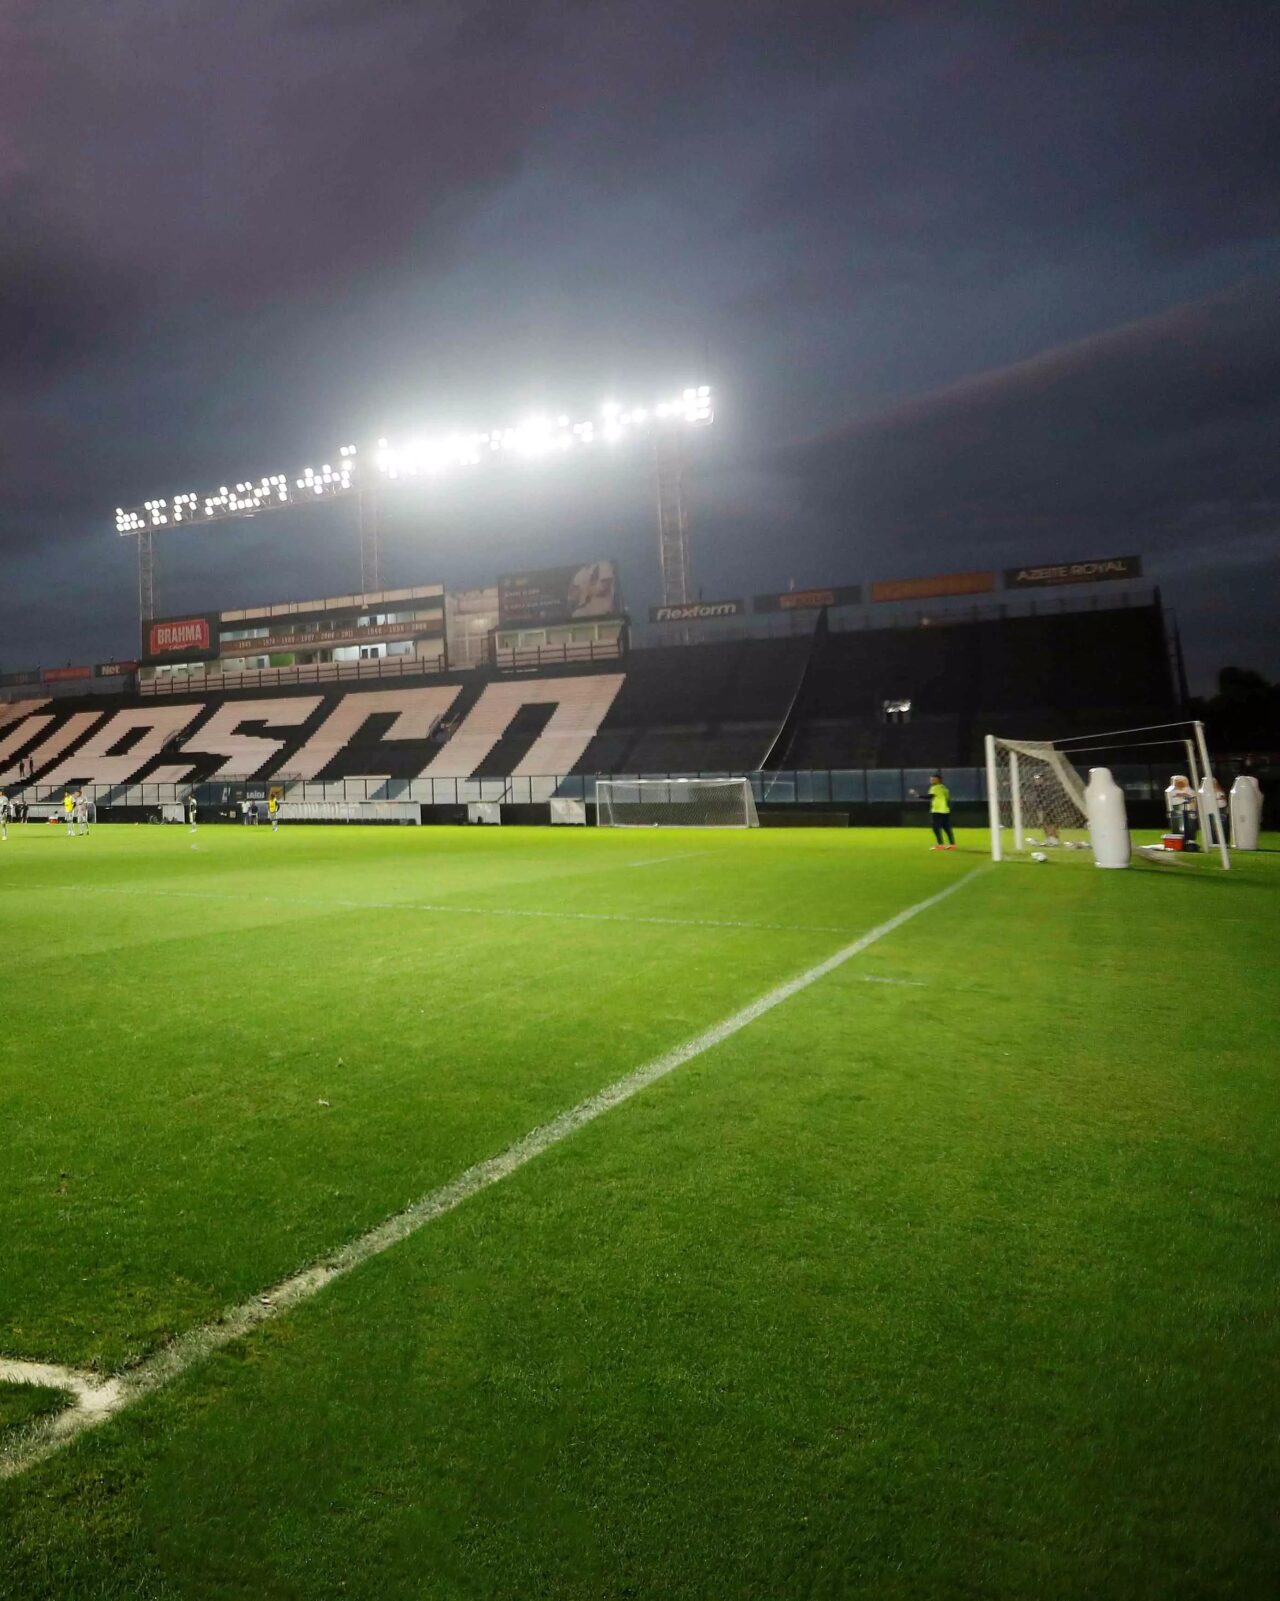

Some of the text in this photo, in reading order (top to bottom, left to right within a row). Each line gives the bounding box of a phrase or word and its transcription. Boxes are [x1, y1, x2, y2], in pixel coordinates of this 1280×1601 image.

[1016, 560, 1128, 581] AZEITE ROYAL
[657, 602, 737, 620] Flexform
[157, 624, 203, 645] BRAHMA
